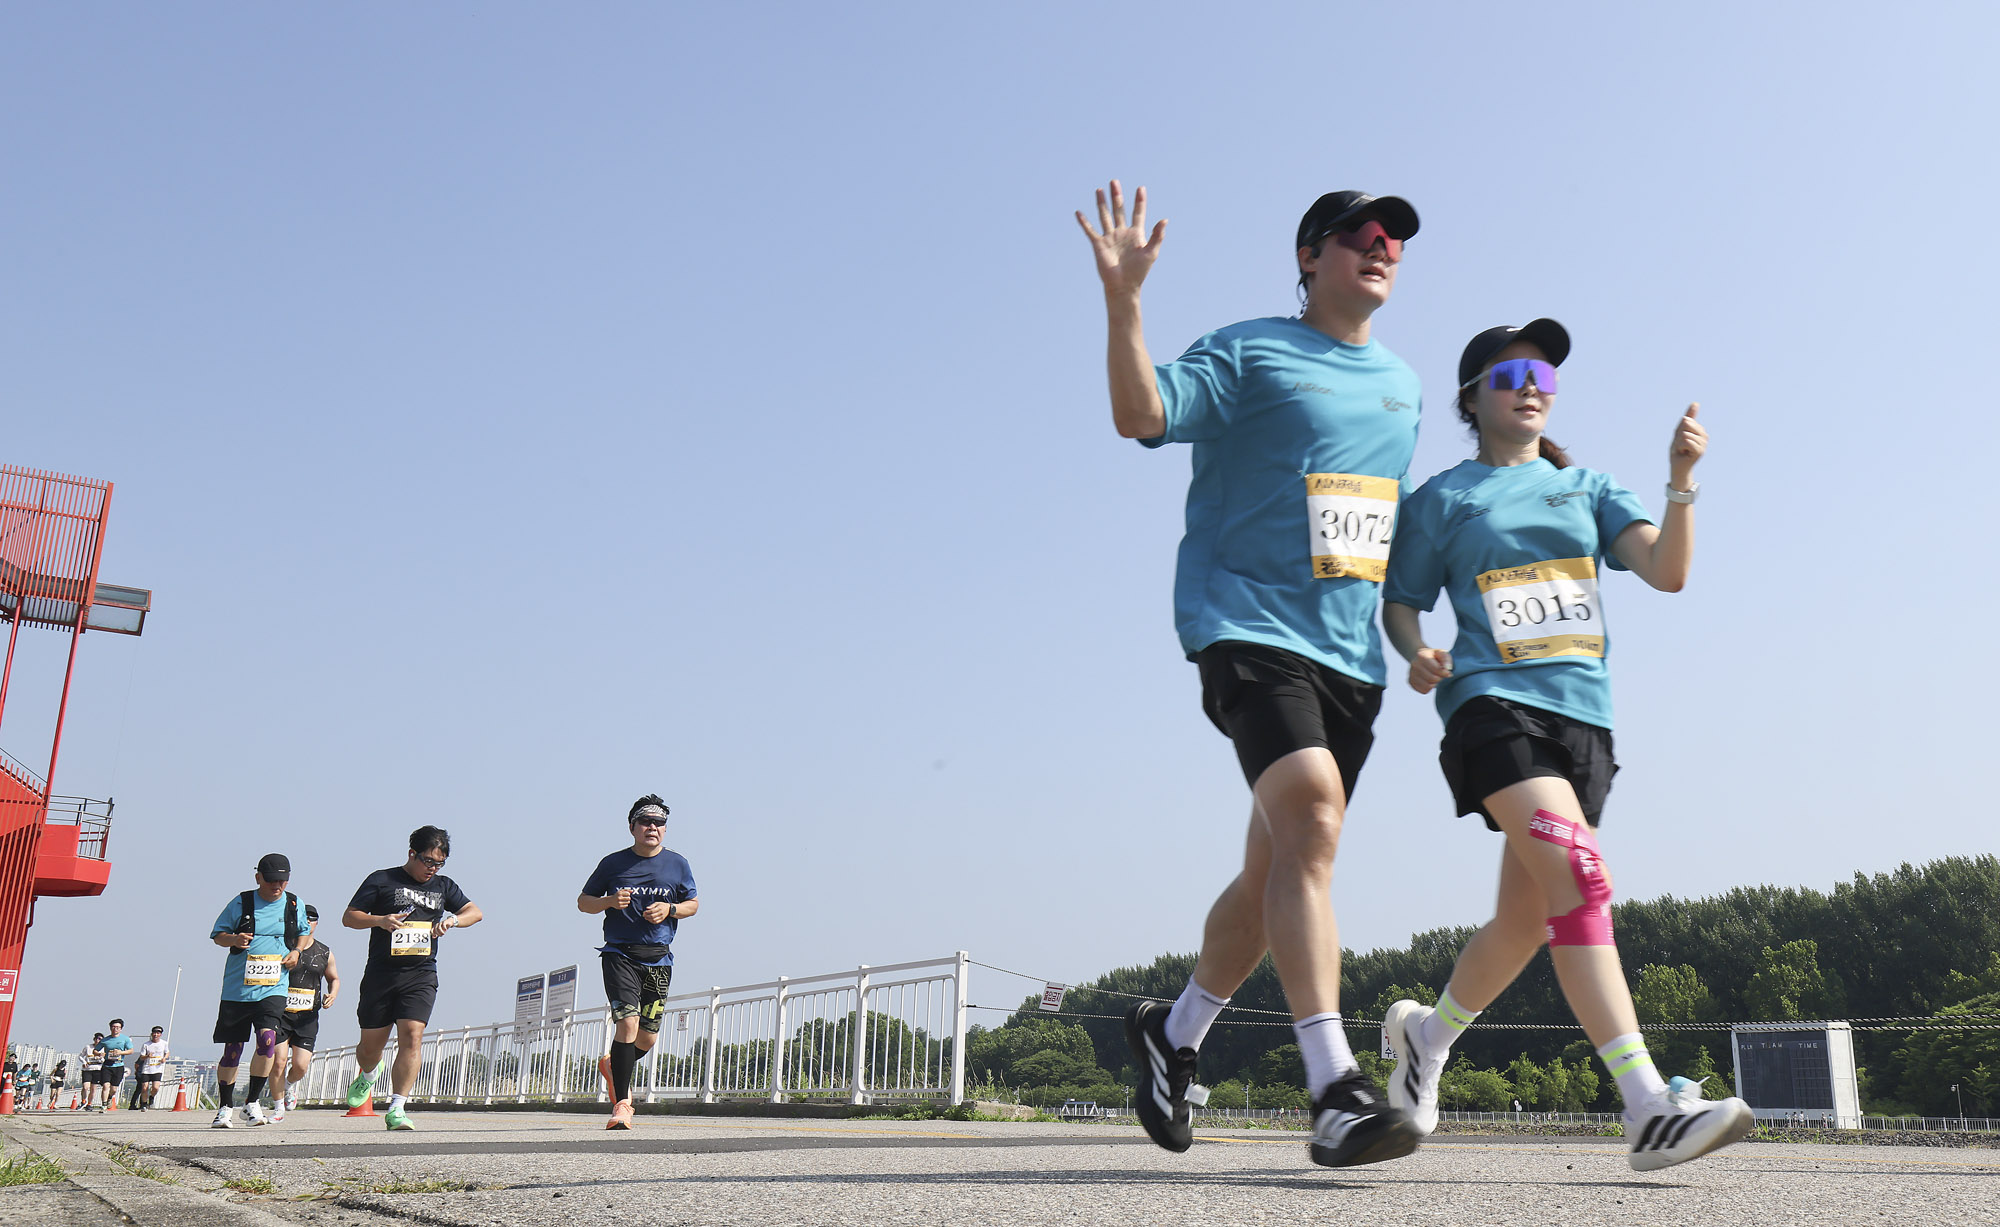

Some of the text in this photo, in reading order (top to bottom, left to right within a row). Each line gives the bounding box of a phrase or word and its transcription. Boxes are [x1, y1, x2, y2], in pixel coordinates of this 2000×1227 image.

[1320, 509, 1393, 544] 3072
[1498, 593, 1591, 627] 3015
[616, 886, 671, 897] XYMIX
[395, 933, 429, 944] 2138
[248, 965, 279, 975] 3223
[288, 996, 311, 1006] 3208
